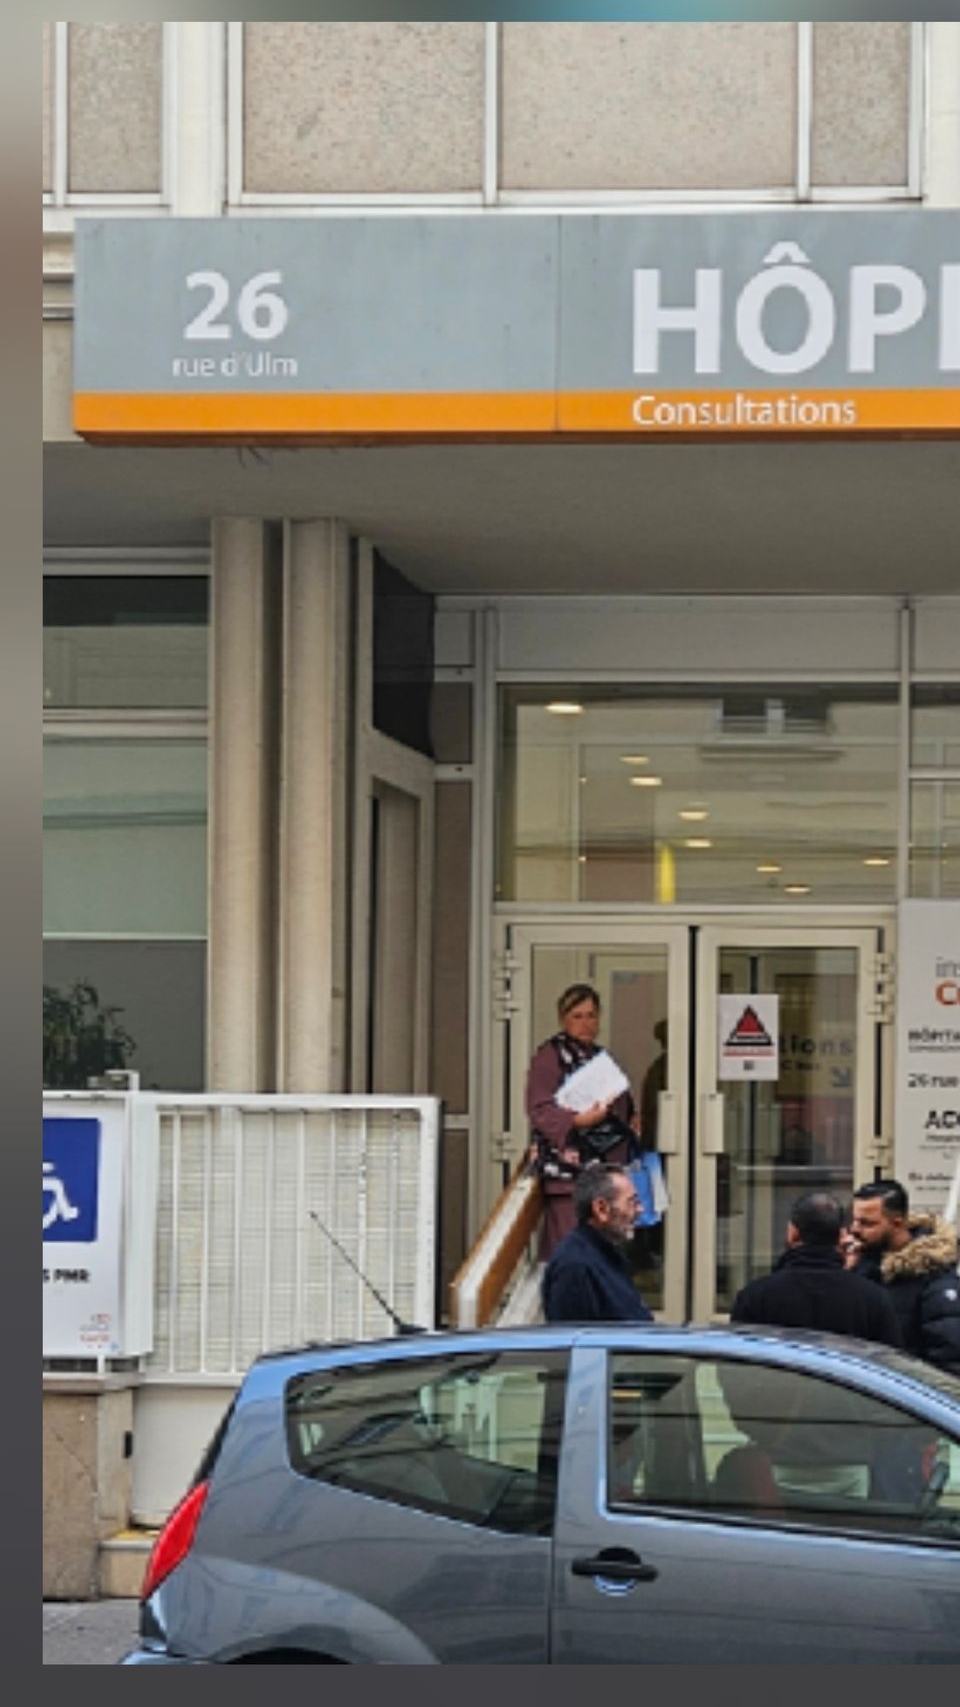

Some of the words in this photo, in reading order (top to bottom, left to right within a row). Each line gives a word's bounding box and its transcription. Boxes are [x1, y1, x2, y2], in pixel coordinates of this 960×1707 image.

[185, 270, 288, 340] 26
[172, 357, 216, 377] rue
[221, 351, 299, 377] d'Ulm
[632, 393, 857, 427] Consultations
